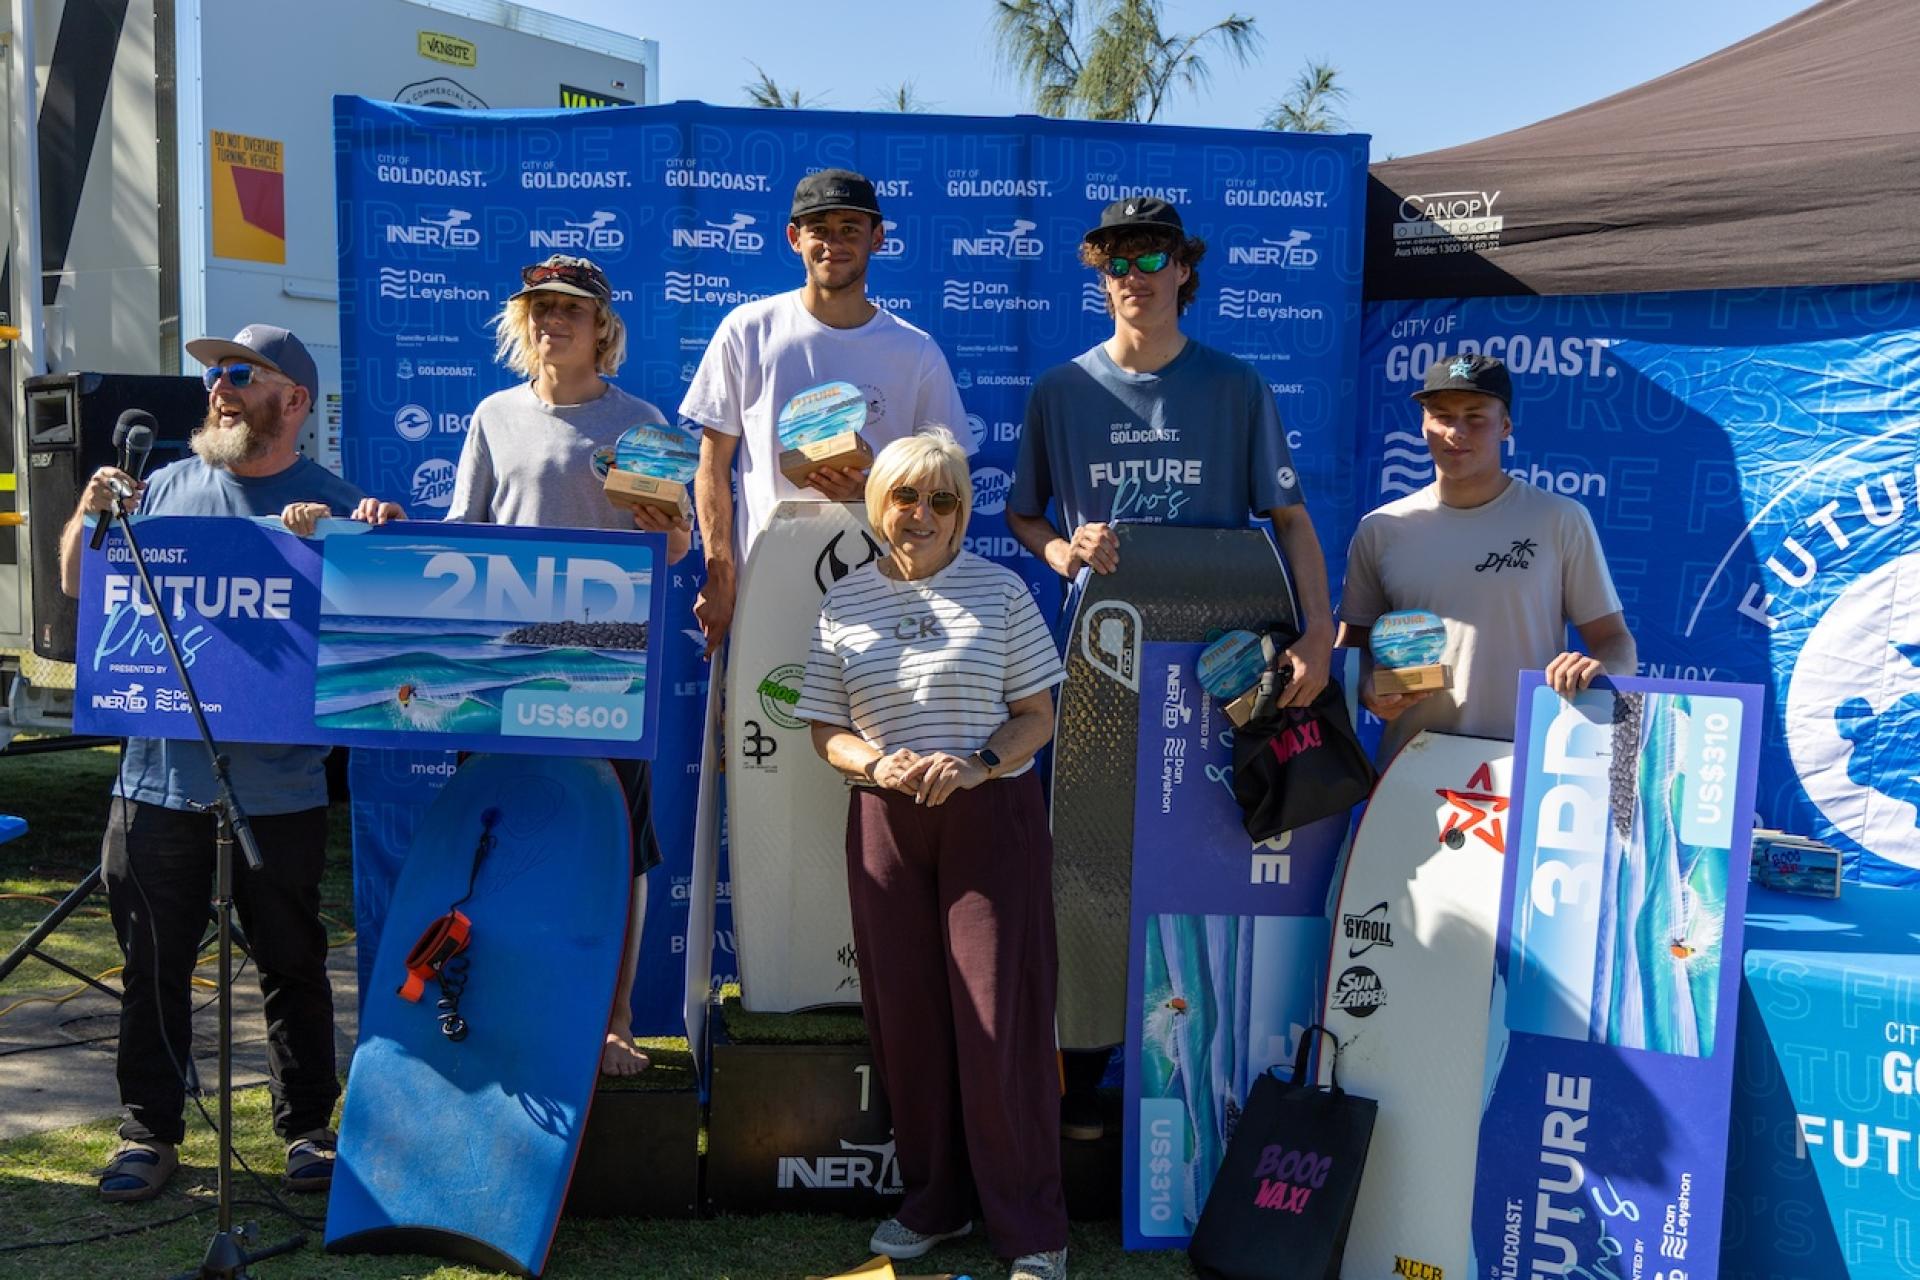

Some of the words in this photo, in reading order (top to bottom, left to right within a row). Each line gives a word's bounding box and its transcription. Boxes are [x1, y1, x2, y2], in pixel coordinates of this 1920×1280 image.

[426, 37, 470, 60] VANSITE
[411, 86, 464, 104] COMMERCIAL
[214, 131, 224, 146] DO
[227, 133, 240, 149] NOT
[244, 136, 279, 155] OVERTAKE
[217, 147, 246, 165] TURNING
[250, 152, 278, 170] VEHICLE
[377, 165, 488, 188] GOLDCOAST.
[521, 171, 632, 189] GOLDCOAST.
[665, 169, 771, 192] GOLDCOAST.
[947, 180, 1053, 198] GOLDCOAST.
[1225, 189, 1328, 208] GOLDCOAST.
[1399, 190, 1501, 222] CANOPY
[409, 269, 446, 284] Dan
[694, 272, 730, 288] Dan
[972, 280, 1009, 295] Dan
[409, 285, 490, 304] Leyshon
[693, 288, 771, 306] Leysho
[972, 296, 1050, 314] Leyshon
[1248, 290, 1282, 304] Dan
[1246, 304, 1323, 323] Leyshon
[1391, 318, 1431, 339] CITY
[1434, 314, 1457, 336] OF
[417, 366, 477, 376] GOLDCOAST.
[977, 375, 1033, 386] GOLDCOAST.
[1269, 383, 1305, 394] COAST.
[1110, 428, 1181, 445] GOLDCOAST.
[1089, 458, 1203, 488] FUTURE
[1503, 463, 1606, 497] shon
[107, 547, 188, 564] GOLCOAST.
[1737, 463, 1920, 631] FUTU
[104, 574, 293, 620] FUTURE
[421, 551, 636, 624] 2ND
[109, 663, 155, 674] PRESENTED
[156, 665, 167, 674] BY
[173, 689, 189, 700] Da
[173, 701, 222, 713] Leyhon
[517, 703, 629, 730] US$600
[1269, 720, 1322, 765] WAX!
[1174, 757, 1184, 784] Dan
[1695, 712, 1730, 826] US$310
[1162, 758, 1174, 814] Leyshon
[1345, 918, 1391, 943] GYROLL
[1340, 972, 1377, 991] SUN
[853, 1064, 872, 1112] 1
[1795, 1113, 1920, 1177] FUT
[1150, 1119, 1172, 1222] US$310
[1531, 1072, 1592, 1280] UTURE
[1255, 1178, 1313, 1214] WAX!
[1676, 1173, 1692, 1236] Leyshon
[1664, 1204, 1677, 1234] Dan
